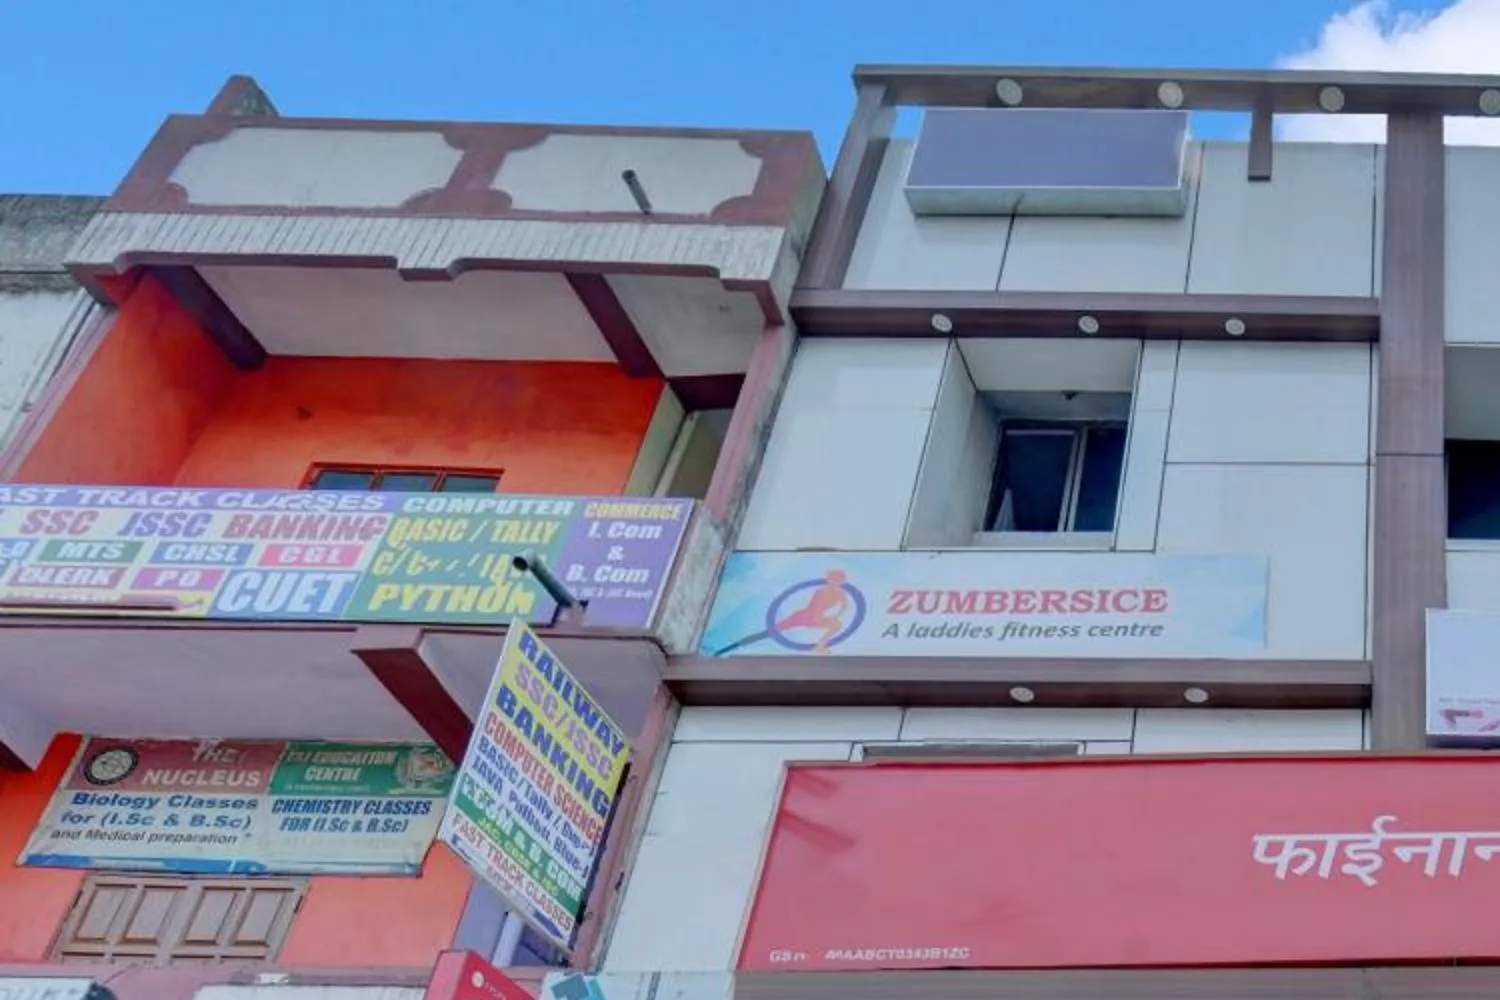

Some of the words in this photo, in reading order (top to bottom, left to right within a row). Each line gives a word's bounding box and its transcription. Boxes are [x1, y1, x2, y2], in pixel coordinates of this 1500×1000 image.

[77, 489, 207, 508] TRACK
[216, 490, 385, 511] CLASSES
[402, 496, 575, 516] COMPUTER
[584, 502, 683, 521] COMMERCE
[19, 510, 99, 535] SSC
[222, 513, 388, 540] BANKING
[490, 520, 560, 543] TALLY
[607, 521, 661, 540] Com
[57, 541, 126, 560] MTS
[164, 544, 239, 563] CHSL
[277, 547, 342, 565] CGL
[594, 565, 650, 582] Com
[217, 572, 359, 613] CUET
[368, 584, 535, 613] PYTHON
[887, 589, 1168, 614] ZUMBERSICE
[882, 623, 900, 638] A
[906, 622, 995, 638] laddies
[999, 621, 1080, 641] fitness
[1087, 622, 1164, 638] centre
[516, 627, 626, 762] RAILWAY
[482, 708, 557, 798] COMPUTER
[493, 681, 612, 820] BANKING
[141, 769, 261, 787] NUCLEUS
[71, 792, 161, 810] Biology
[167, 795, 259, 810] Classes
[272, 799, 362, 815] CHEMISTRY
[364, 801, 432, 815] CLASSES
[60, 810, 94, 823] for
[163, 814, 180, 827] &
[280, 817, 311, 832] FOR
[351, 820, 363, 832] &
[51, 829, 82, 840] and
[85, 829, 145, 842] Medical
[149, 832, 238, 845] preparation
[485, 843, 525, 889] TRACK
